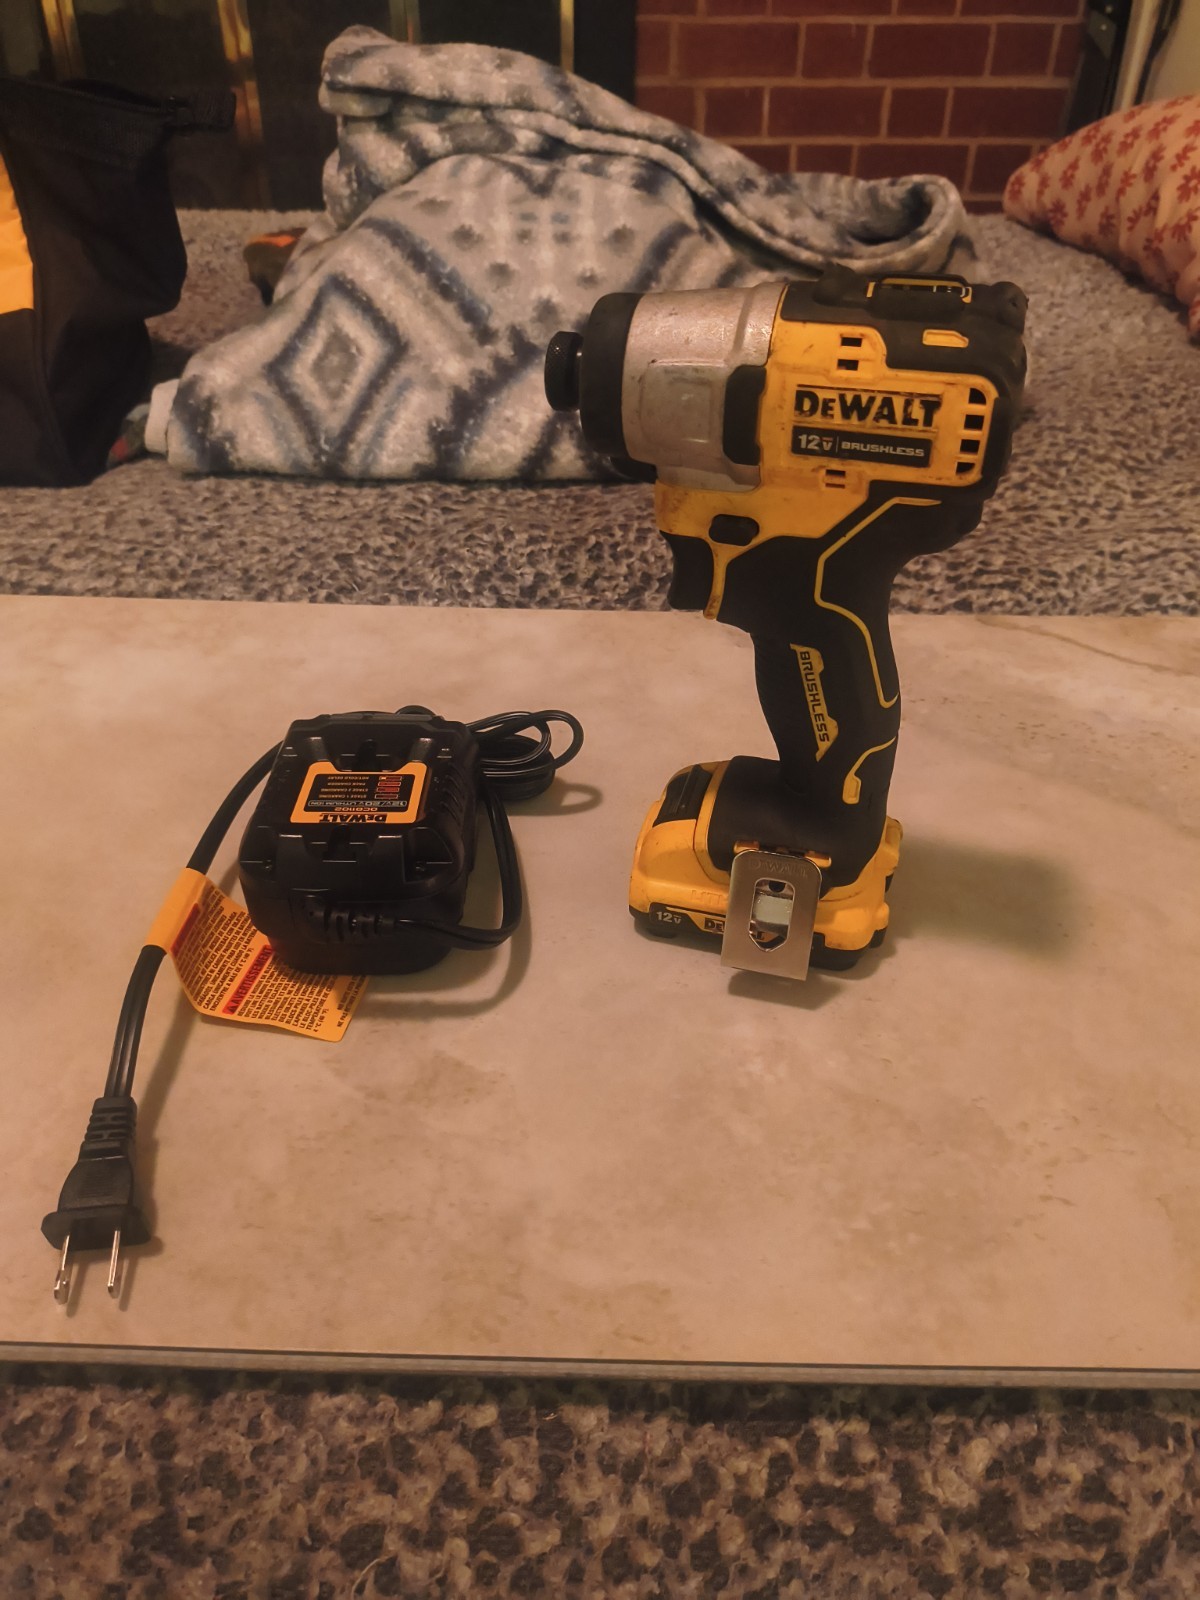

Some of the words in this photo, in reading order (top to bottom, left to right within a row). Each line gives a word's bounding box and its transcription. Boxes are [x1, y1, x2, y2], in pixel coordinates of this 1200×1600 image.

[841, 441, 925, 457] BRUSHLESS
[800, 650, 829, 742] BRUSHLESS
[232, 946, 274, 1004] AVERTISSEMENT
